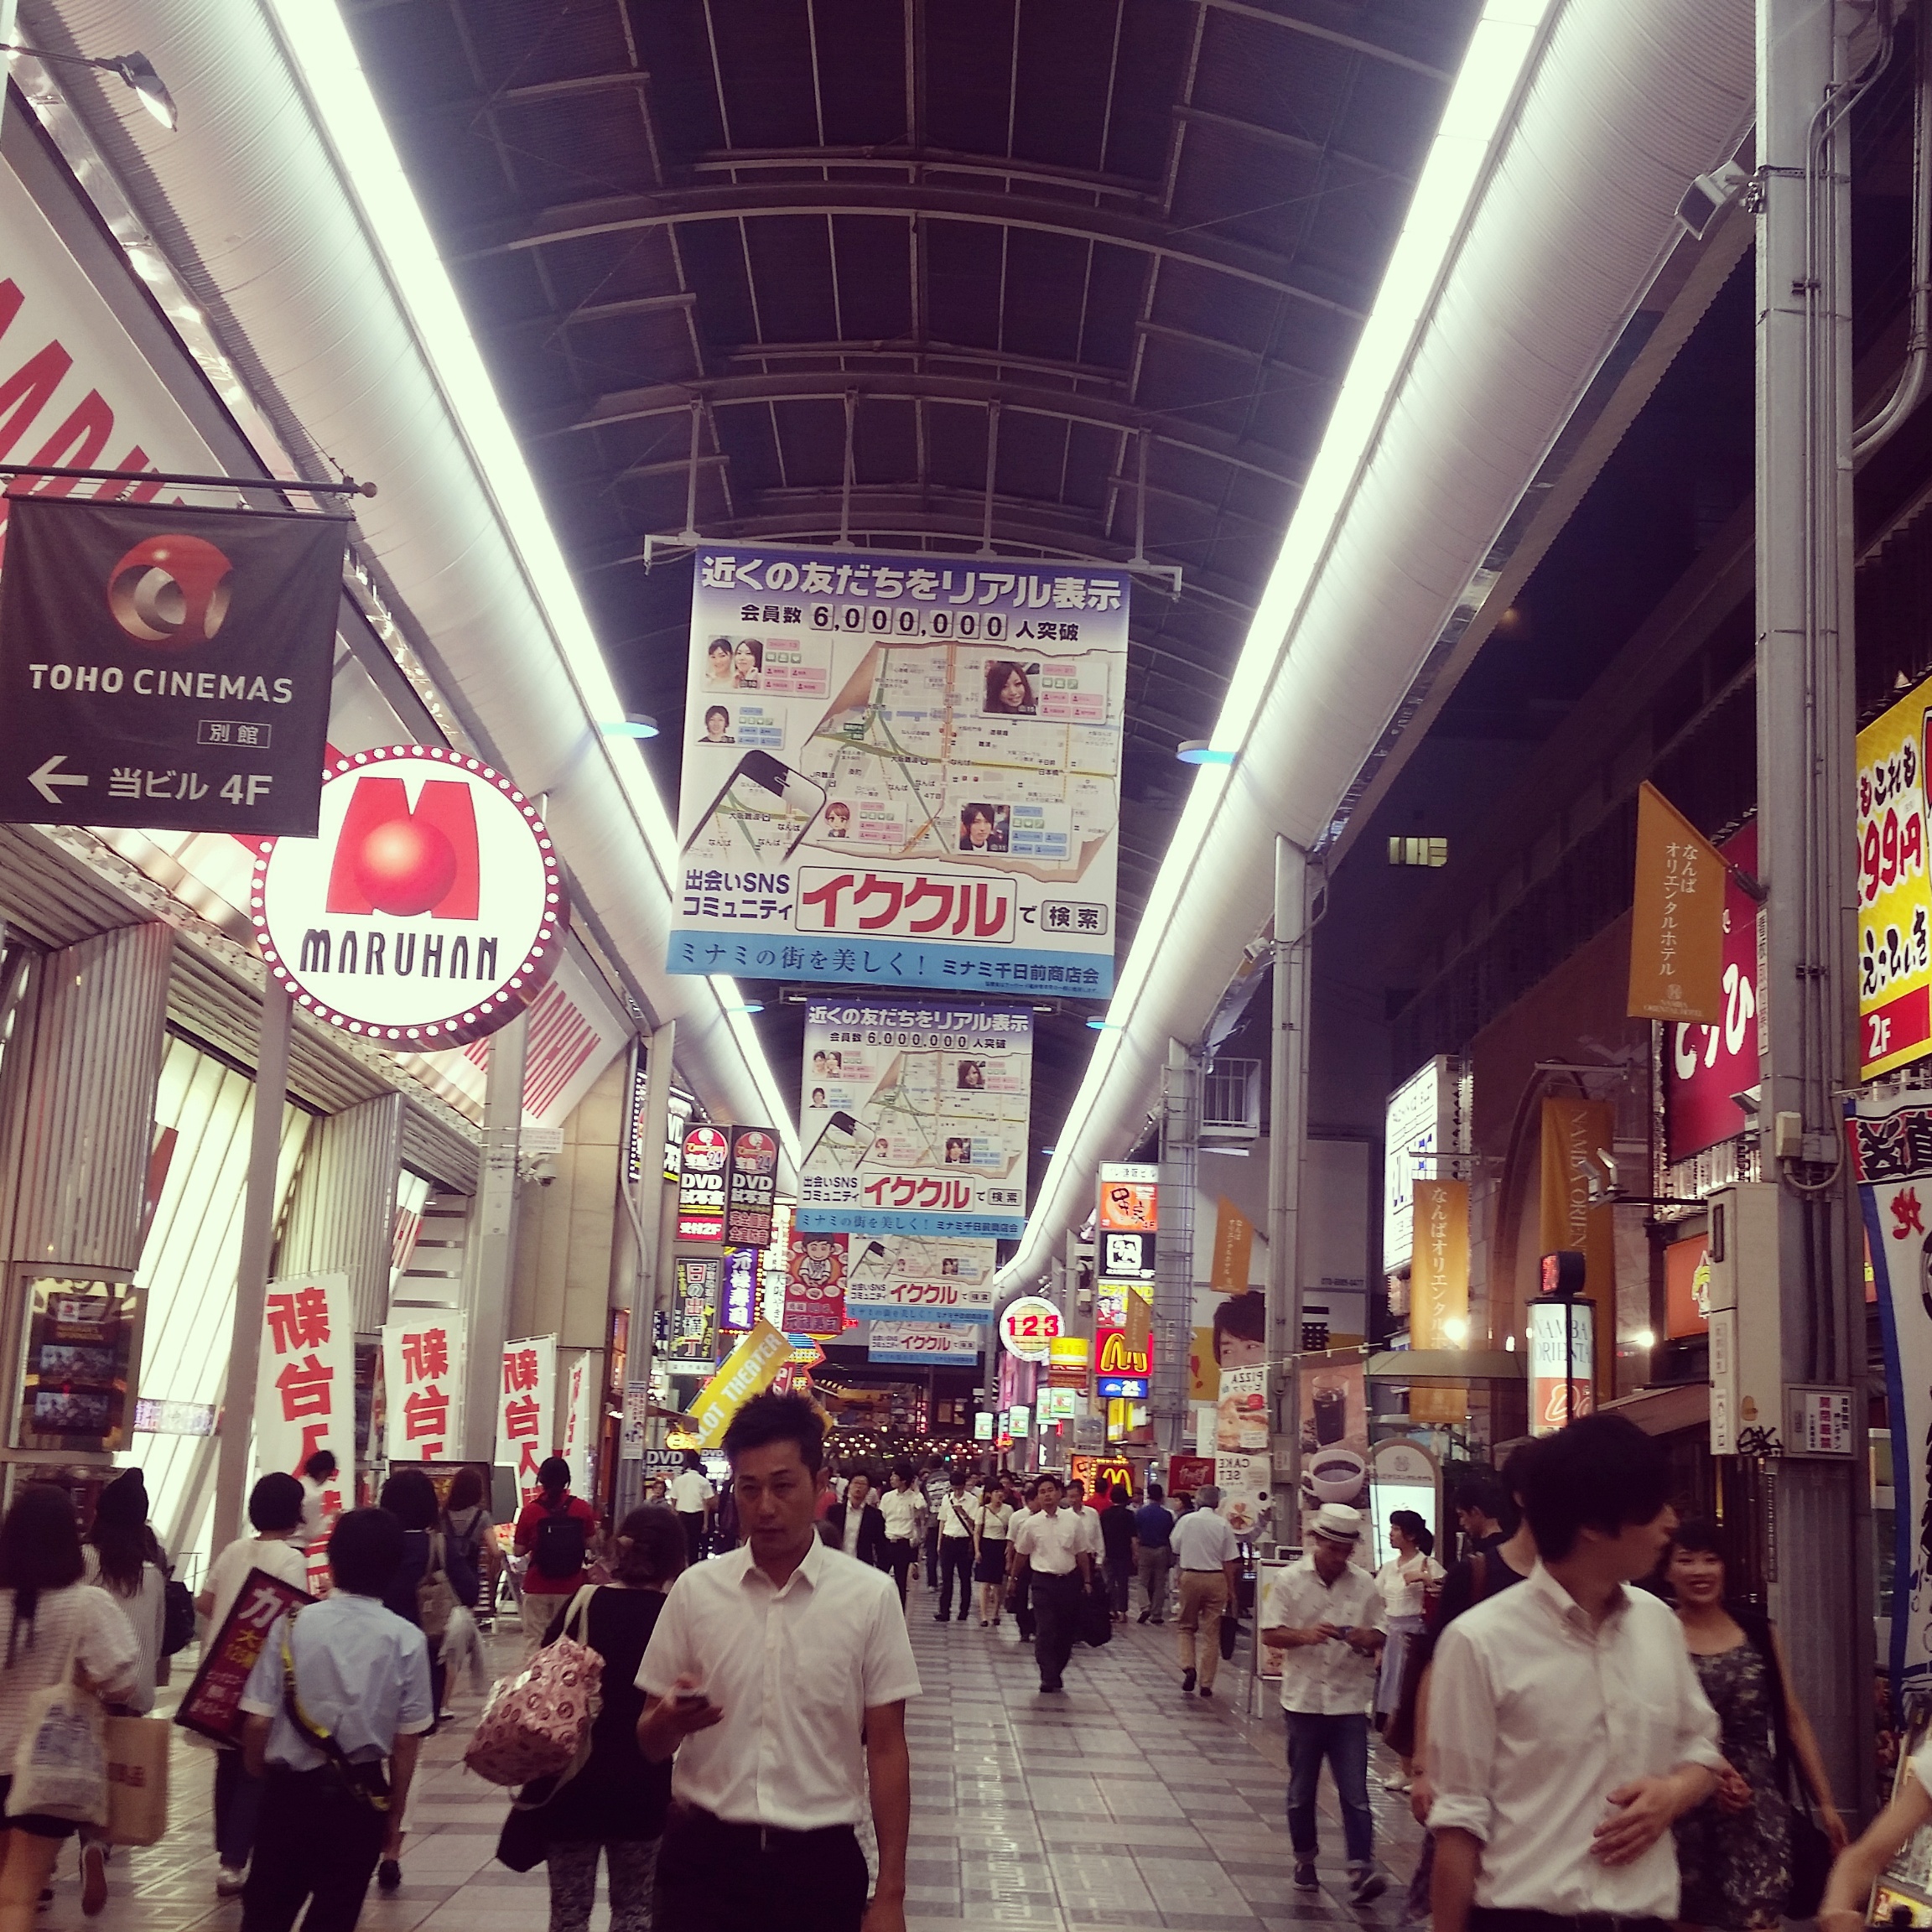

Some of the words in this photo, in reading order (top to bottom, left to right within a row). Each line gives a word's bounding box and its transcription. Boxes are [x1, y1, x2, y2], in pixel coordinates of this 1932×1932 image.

[702, 556, 1121, 611] 近くの友だちをリアル表示
[741, 604, 802, 624] 会員数
[813, 606, 1003, 637] 6,000,000
[1015, 620, 1079, 641] 人突破
[29, 664, 123, 693] TOHO
[133, 669, 293, 704] CINEMAS
[209, 722, 259, 746] 別館
[108, 768, 209, 801] 当ビル
[220, 776, 273, 805] 4F
[1680, 844, 1699, 894] なんば
[1856, 808, 1921, 904] 99円
[685, 869, 791, 894] 出会いSNS
[683, 896, 792, 920] コミュニティ
[802, 874, 1007, 937] イククル
[1020, 906, 1037, 923] で
[1049, 906, 1099, 929] 検索
[1659, 841, 1680, 976] オリエンタルホテル
[299, 928, 498, 981] MARUHAN
[682, 943, 925, 976] ミナミの街を美しく！
[943, 958, 1100, 985] ミナミ千日前商店会
[808, 1006, 1029, 1032] 近くの友だちをリアル表示
[829, 1032, 861, 1042] 会員数
[973, 1037, 1007, 1049] 人突破
[1868, 1014, 1892, 1059] 2F
[682, 1174, 723, 1190] DVD
[732, 1176, 773, 1191] DVD
[802, 1190, 860, 1202] コミュニティ
[803, 1176, 858, 1188] 出会いSNS
[865, 1176, 970, 1208] イククル
[976, 1192, 985, 1202] で
[991, 1192, 1019, 1203] 検索
[891, 1284, 958, 1305] イククル
[1007, 1315, 1059, 1337] 123
[901, 1335, 951, 1351] イククル
[695, 1401, 725, 1446] SLOT
[647, 1451, 684, 1465] DVD
